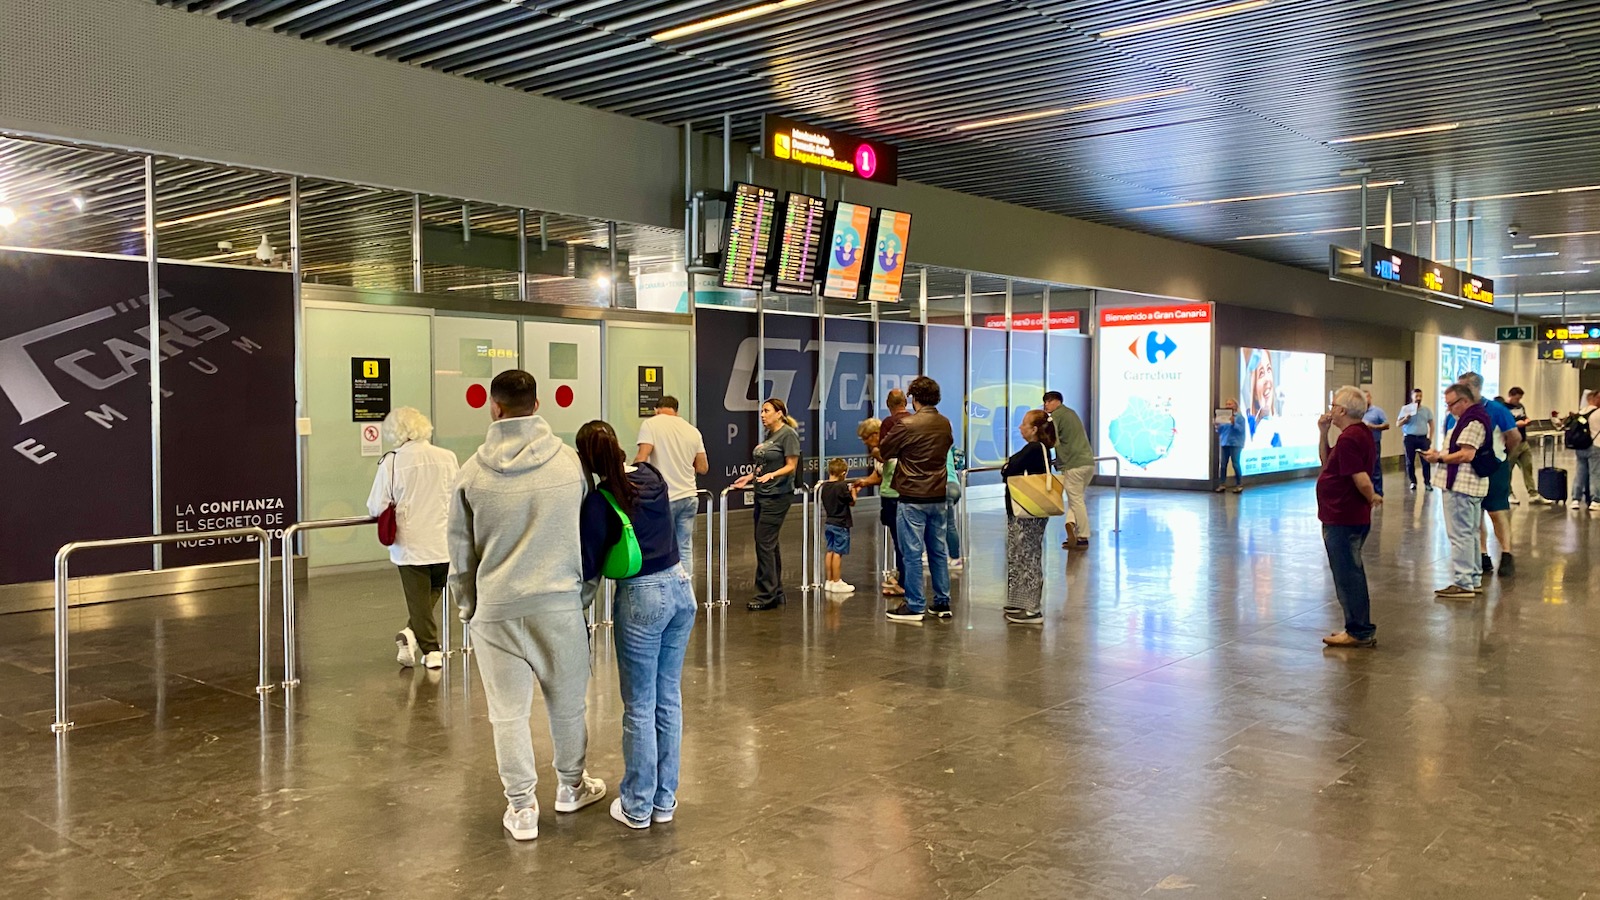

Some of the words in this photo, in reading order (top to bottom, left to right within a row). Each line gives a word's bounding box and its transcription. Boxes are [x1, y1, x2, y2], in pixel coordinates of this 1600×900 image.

[861, 151, 870, 171] 1
[1105, 312, 1147, 322] Bienvenido
[1153, 311, 1174, 320] Gran
[1175, 309, 1207, 319] Canaria
[54, 306, 230, 390] CARS
[725, 465, 738, 477] LA
[176, 503, 195, 517] LA
[200, 498, 284, 513] CONFIANZA
[176, 520, 194, 533] EL
[197, 514, 261, 530] SECRETO
[265, 512, 284, 525] DE
